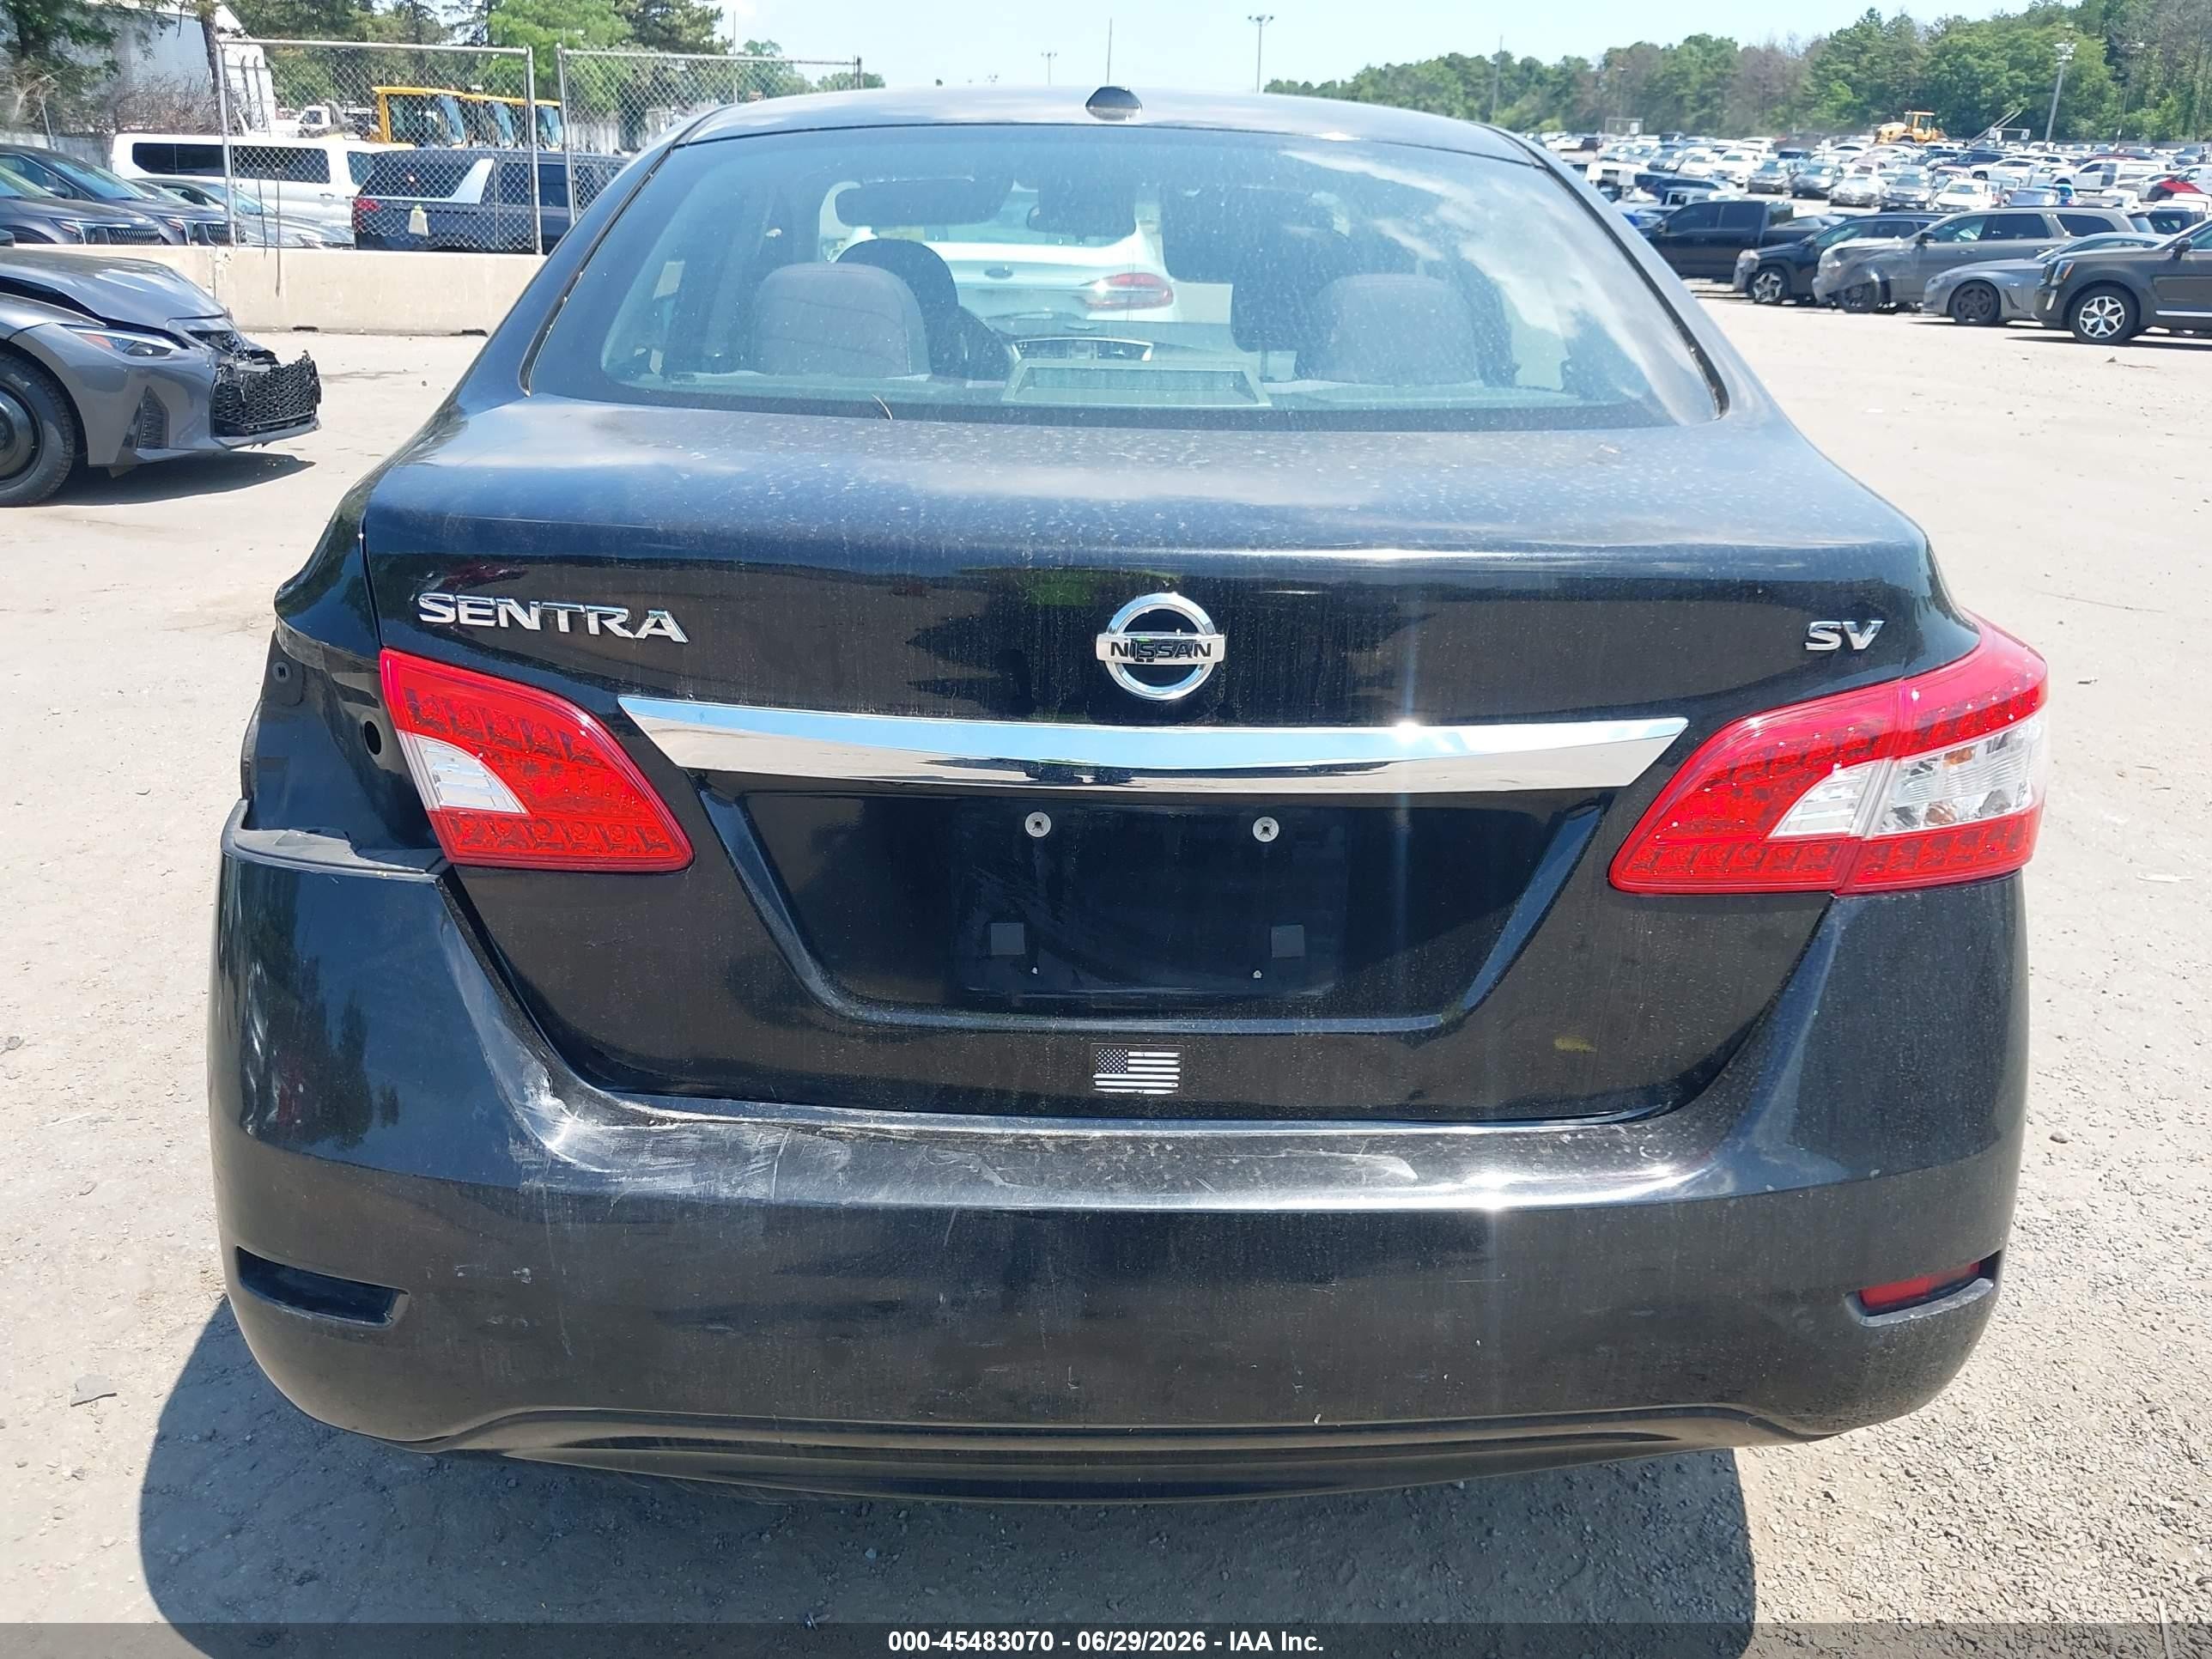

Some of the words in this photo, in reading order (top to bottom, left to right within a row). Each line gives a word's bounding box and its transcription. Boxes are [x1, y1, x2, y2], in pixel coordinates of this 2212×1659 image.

[418, 592, 690, 644] SENTRA
[1109, 639, 1212, 659] NISSAN
[1804, 620, 1886, 651] SV
